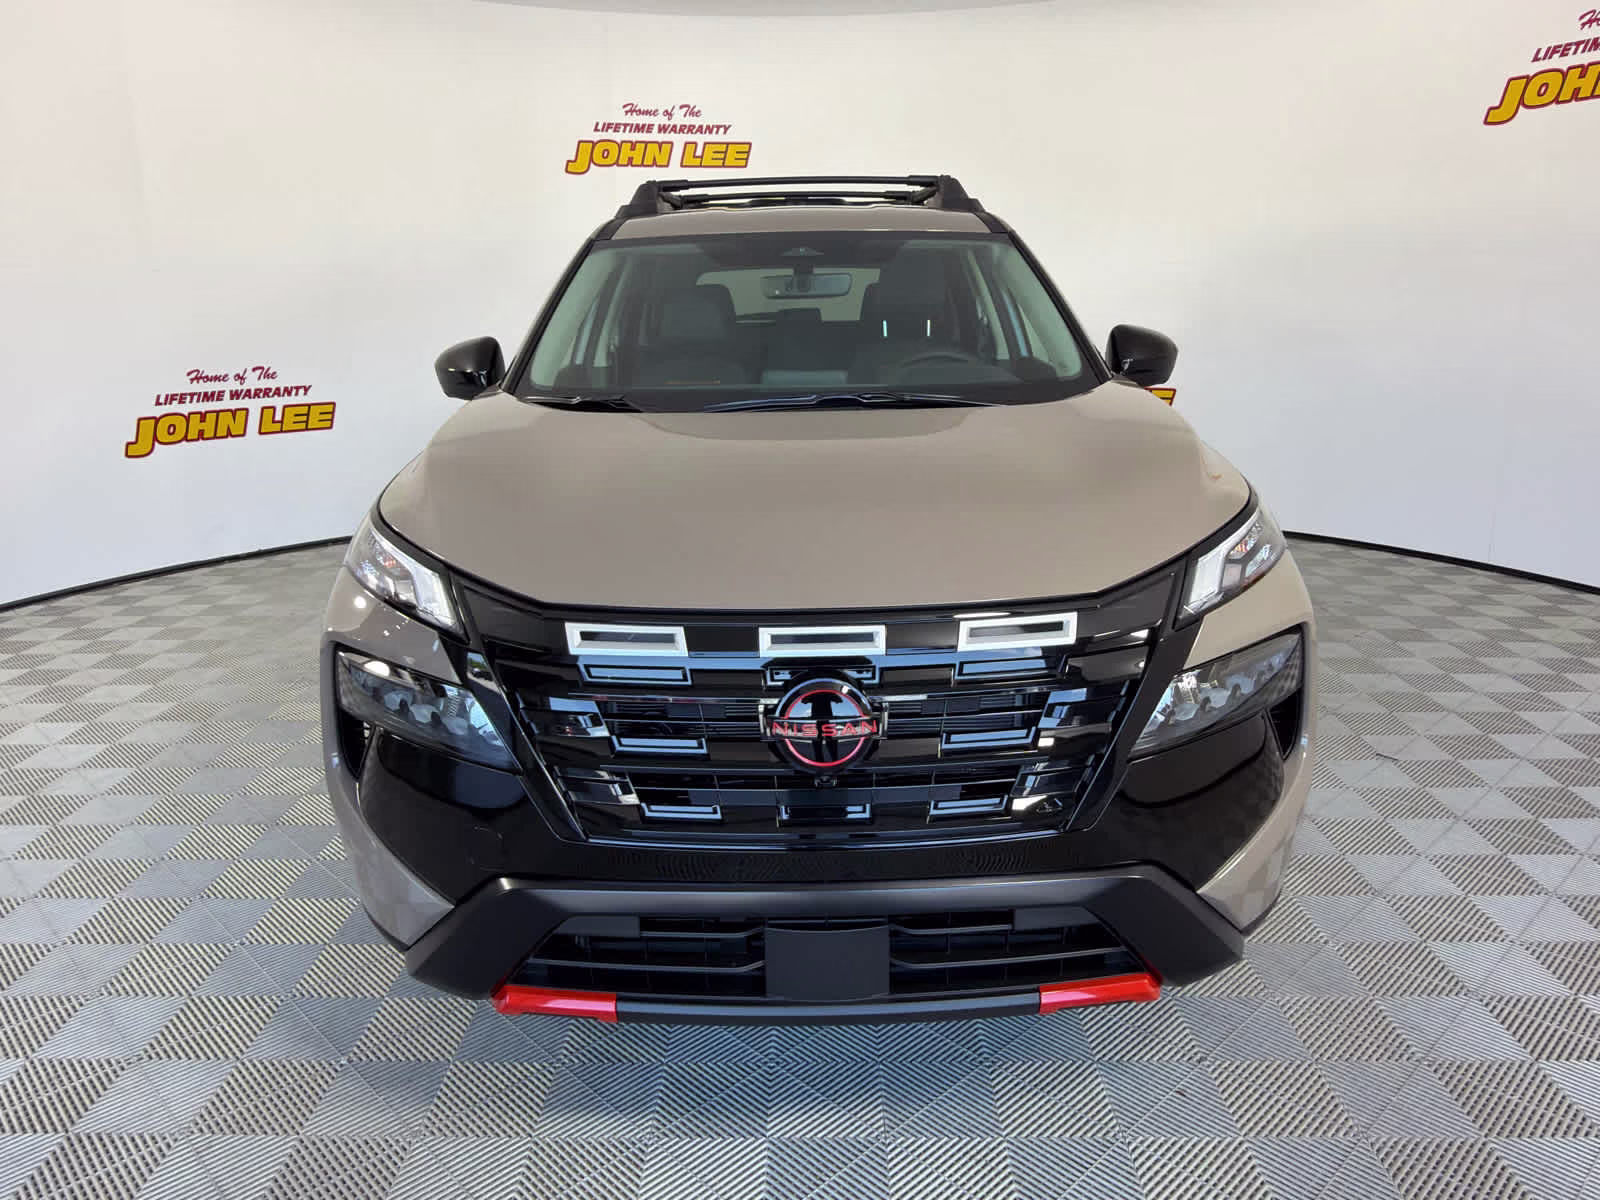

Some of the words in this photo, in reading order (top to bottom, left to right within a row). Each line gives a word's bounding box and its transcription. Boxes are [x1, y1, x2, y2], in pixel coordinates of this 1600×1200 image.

[1483, 60, 1600, 126] JOH
[622, 102, 660, 118] Home
[663, 105, 676, 121] of
[679, 104, 702, 118] The
[593, 121, 655, 134] LIFETIME
[657, 123, 732, 135] WARRANTY
[565, 139, 674, 175] JOHN
[680, 141, 752, 168] LEE
[186, 369, 230, 384] Home
[233, 368, 248, 386] of
[251, 366, 278, 381] The
[154, 389, 226, 407] LIFETIME
[228, 384, 313, 400] WARRANTY
[125, 407, 250, 459] JOHN
[258, 401, 337, 436] LEE
[771, 720, 878, 737] NISSAN
